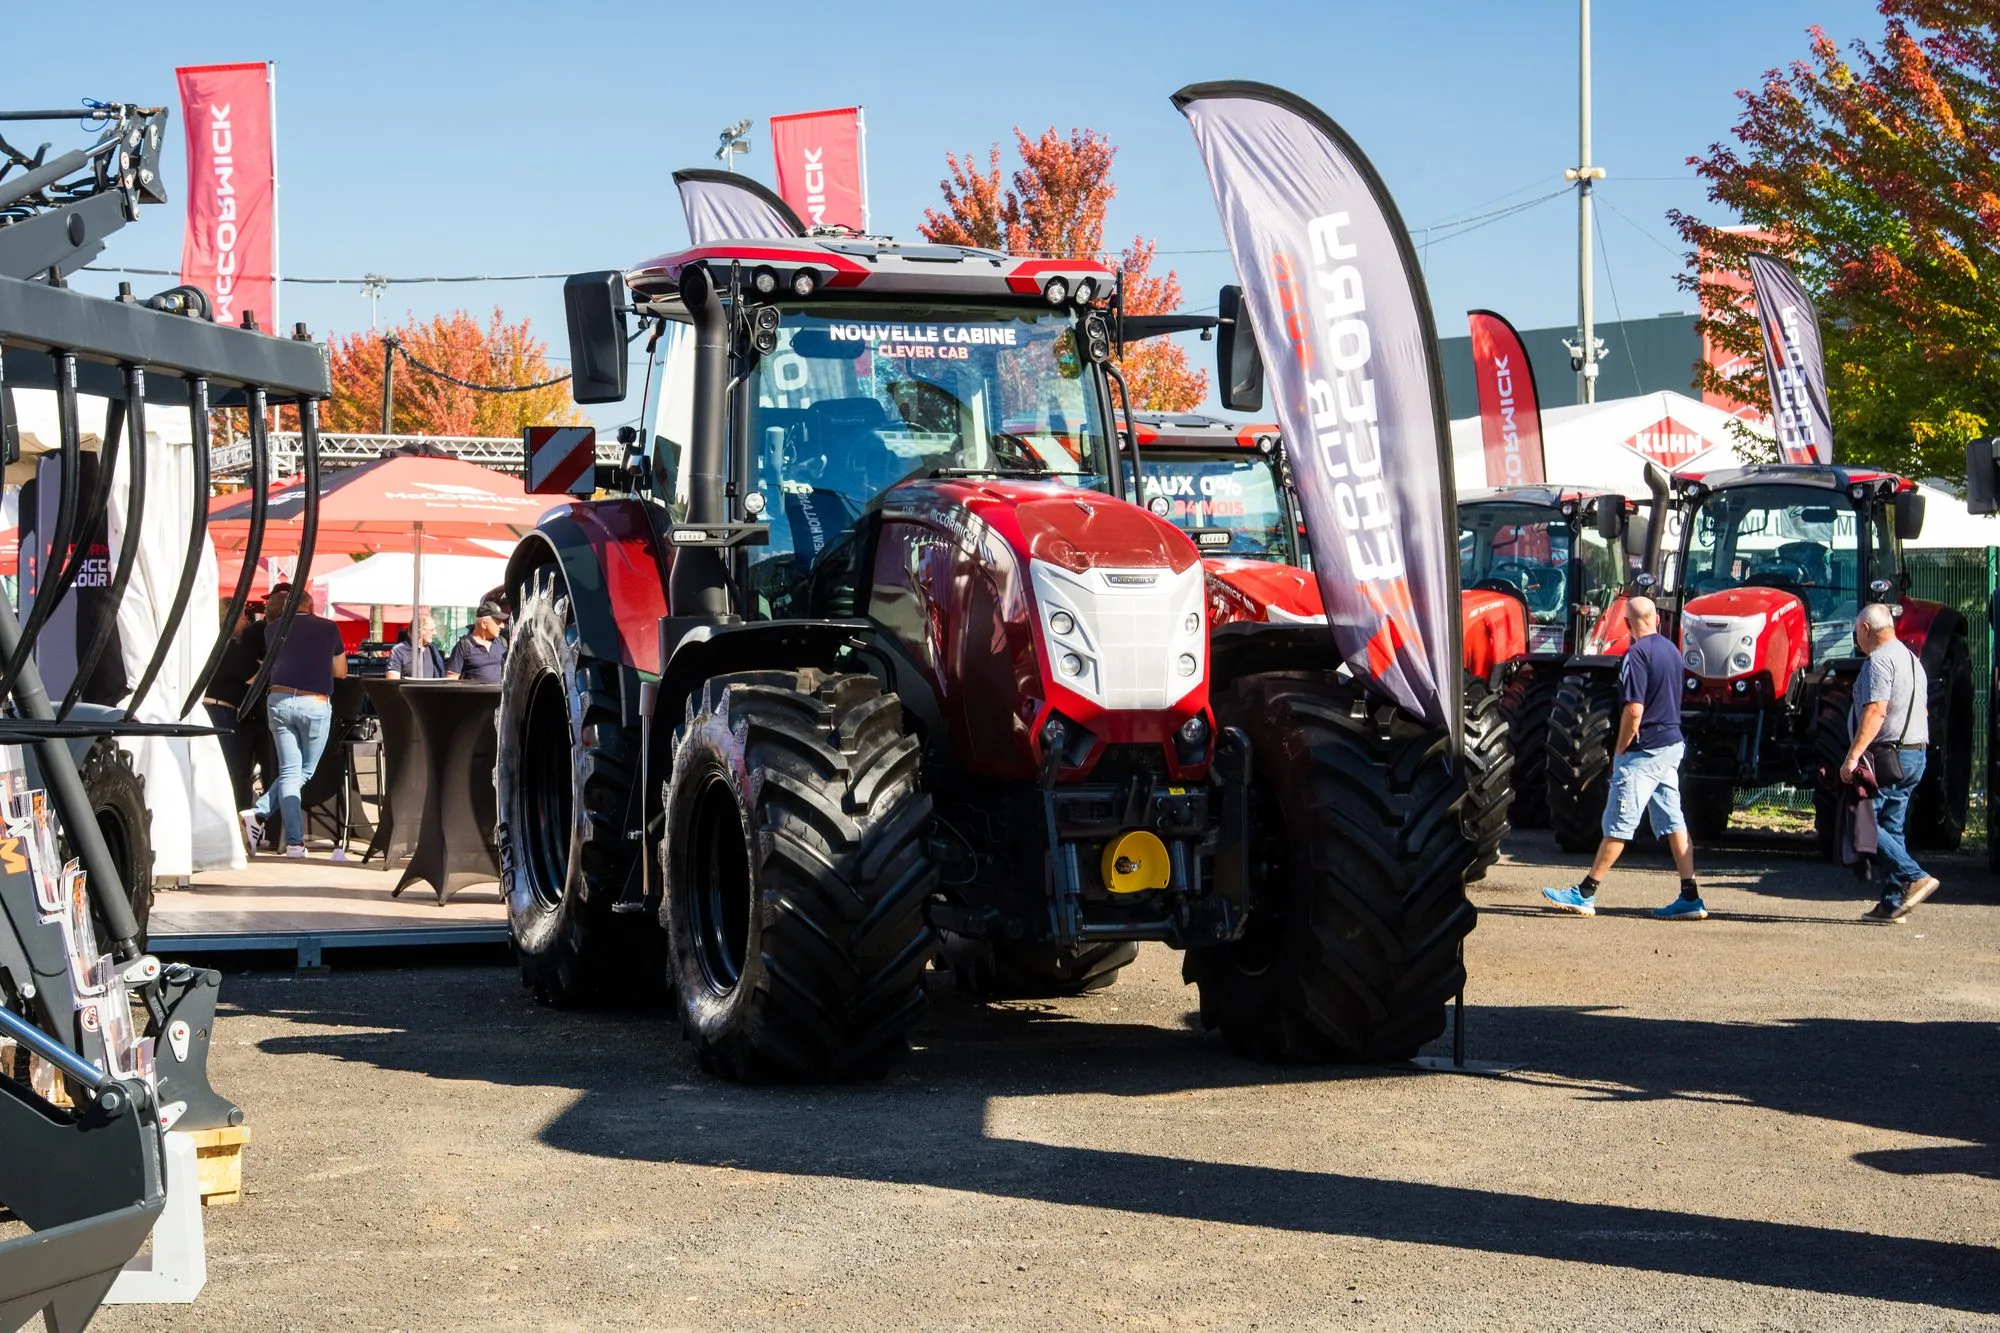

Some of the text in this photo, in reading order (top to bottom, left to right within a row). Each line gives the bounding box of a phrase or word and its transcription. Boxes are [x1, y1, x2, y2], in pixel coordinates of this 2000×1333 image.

[830, 324, 1017, 345] NOUVELLE CABINE
[878, 344, 969, 359] CLEVER CAB
[1636, 433, 1702, 454] KUHN
[1200, 476, 1242, 496] 0%
[1202, 502, 1244, 516] MOIS
[71, 573, 107, 587] OUR
